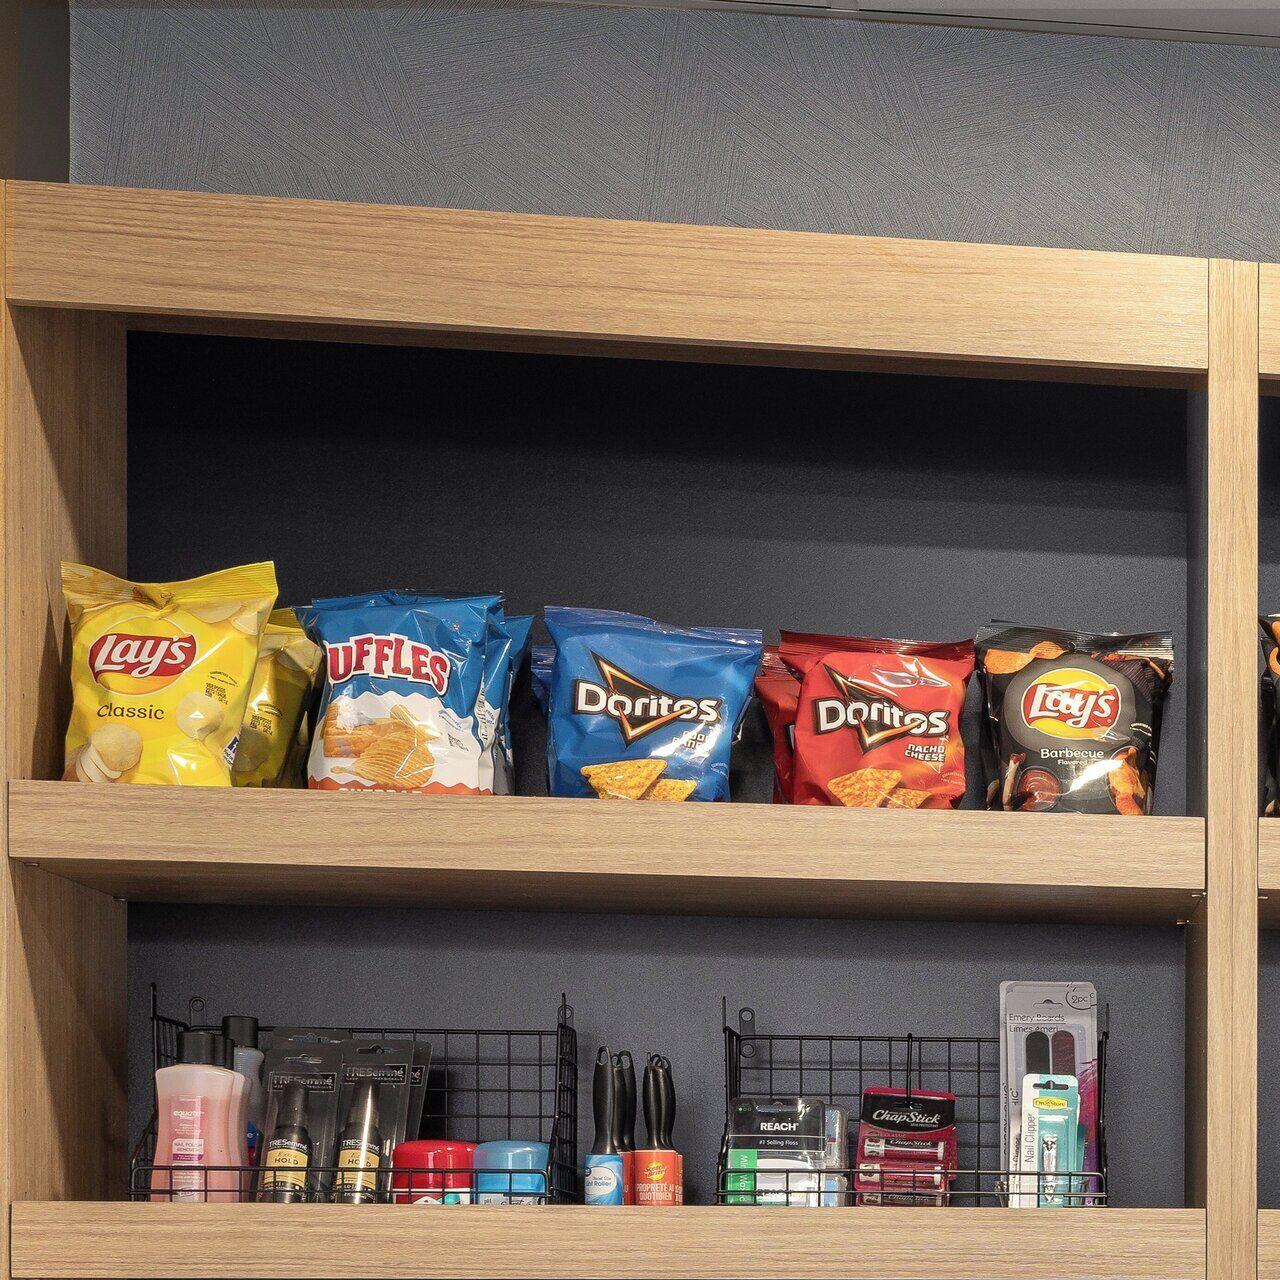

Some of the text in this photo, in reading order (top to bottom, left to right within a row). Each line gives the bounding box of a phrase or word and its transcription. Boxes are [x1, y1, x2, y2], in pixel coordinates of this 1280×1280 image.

[94, 633, 195, 673] Lay's
[577, 682, 718, 722] Doritos
[1031, 684, 1115, 728] Lay's
[97, 702, 164, 720] Classic
[818, 701, 948, 735] Doritos
[908, 745, 945, 753] NACHO
[1041, 749, 1104, 759] Barbecue
[905, 751, 945, 762] CHEESE
[1009, 1014, 1065, 1023] Emery Boards
[1009, 1025, 1033, 1033] Limes
[873, 1110, 938, 1123] ChapStick
[760, 1122, 796, 1131] REACH
[1025, 1113, 1036, 1163] Nail Clipper
[640, 1192, 672, 1200] QUOTIDIEN
